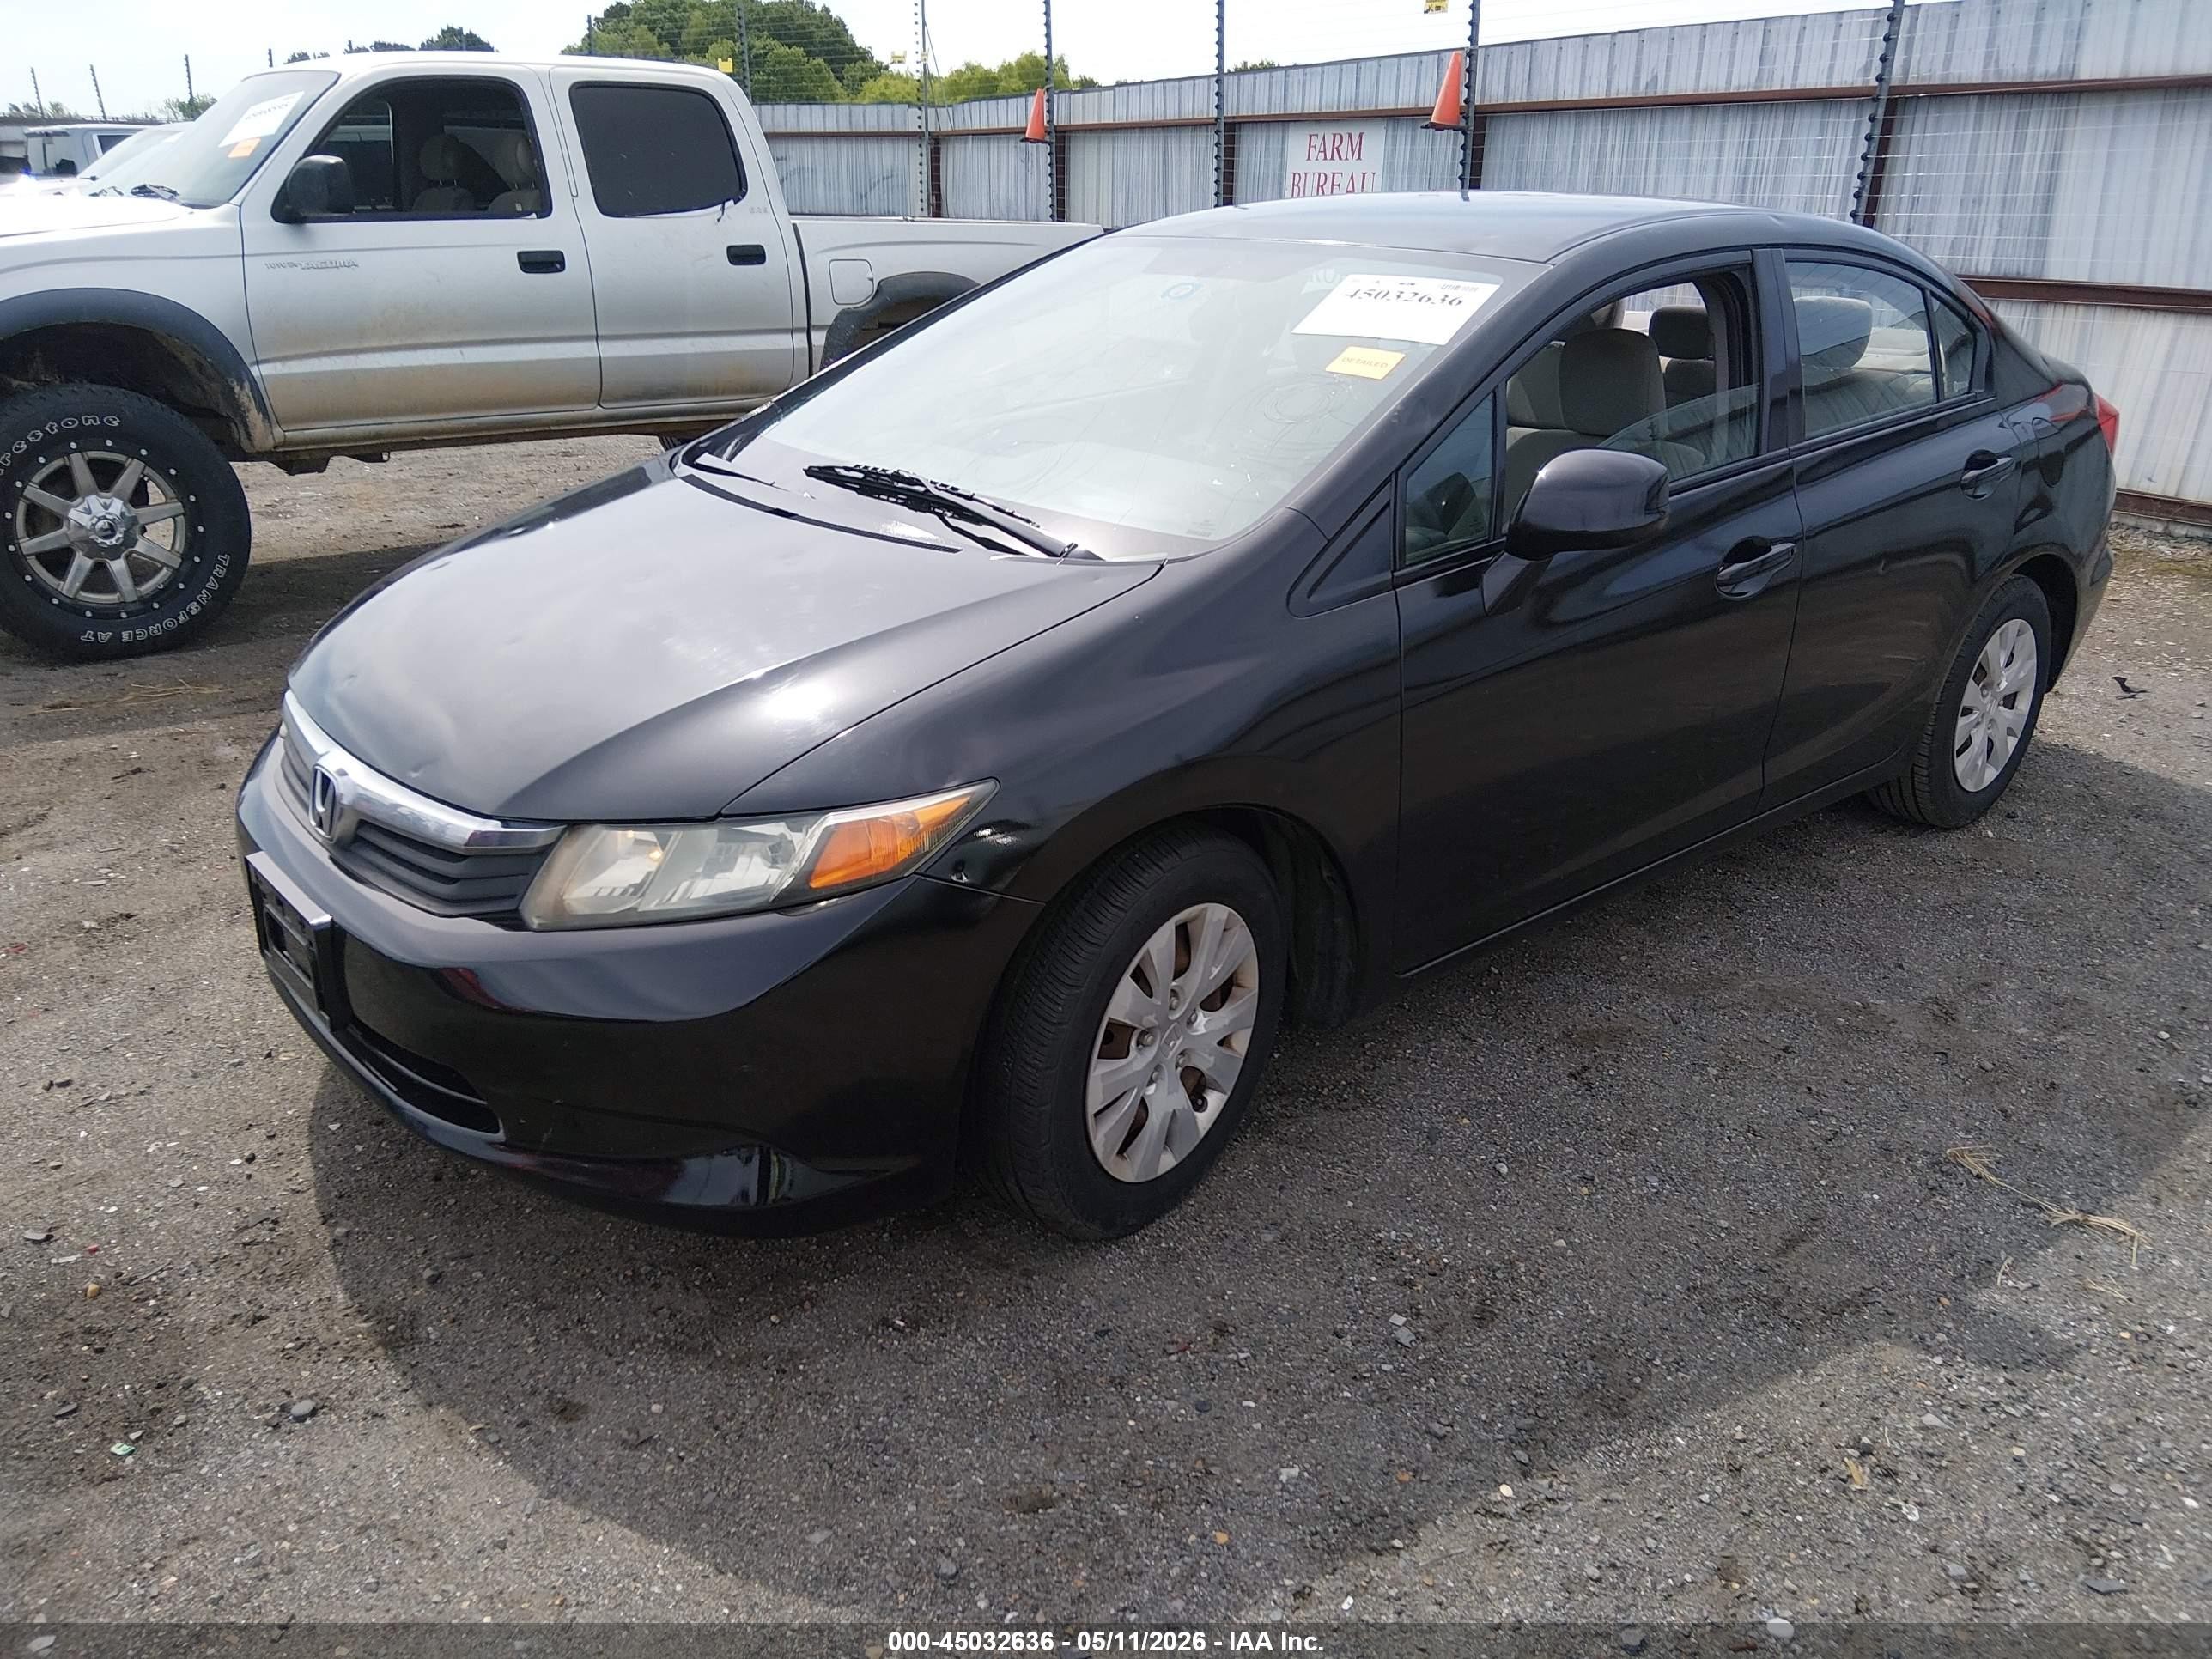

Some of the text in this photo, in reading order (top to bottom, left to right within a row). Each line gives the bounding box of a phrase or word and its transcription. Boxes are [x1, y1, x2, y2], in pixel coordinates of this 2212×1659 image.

[1305, 131, 1365, 161] FARM
[1291, 171, 1377, 198] BUREAU
[1345, 289, 1463, 307] 45032636
[1341, 356, 1389, 369] DETAILED
[80, 554, 230, 642] TRANSFORCE AT
